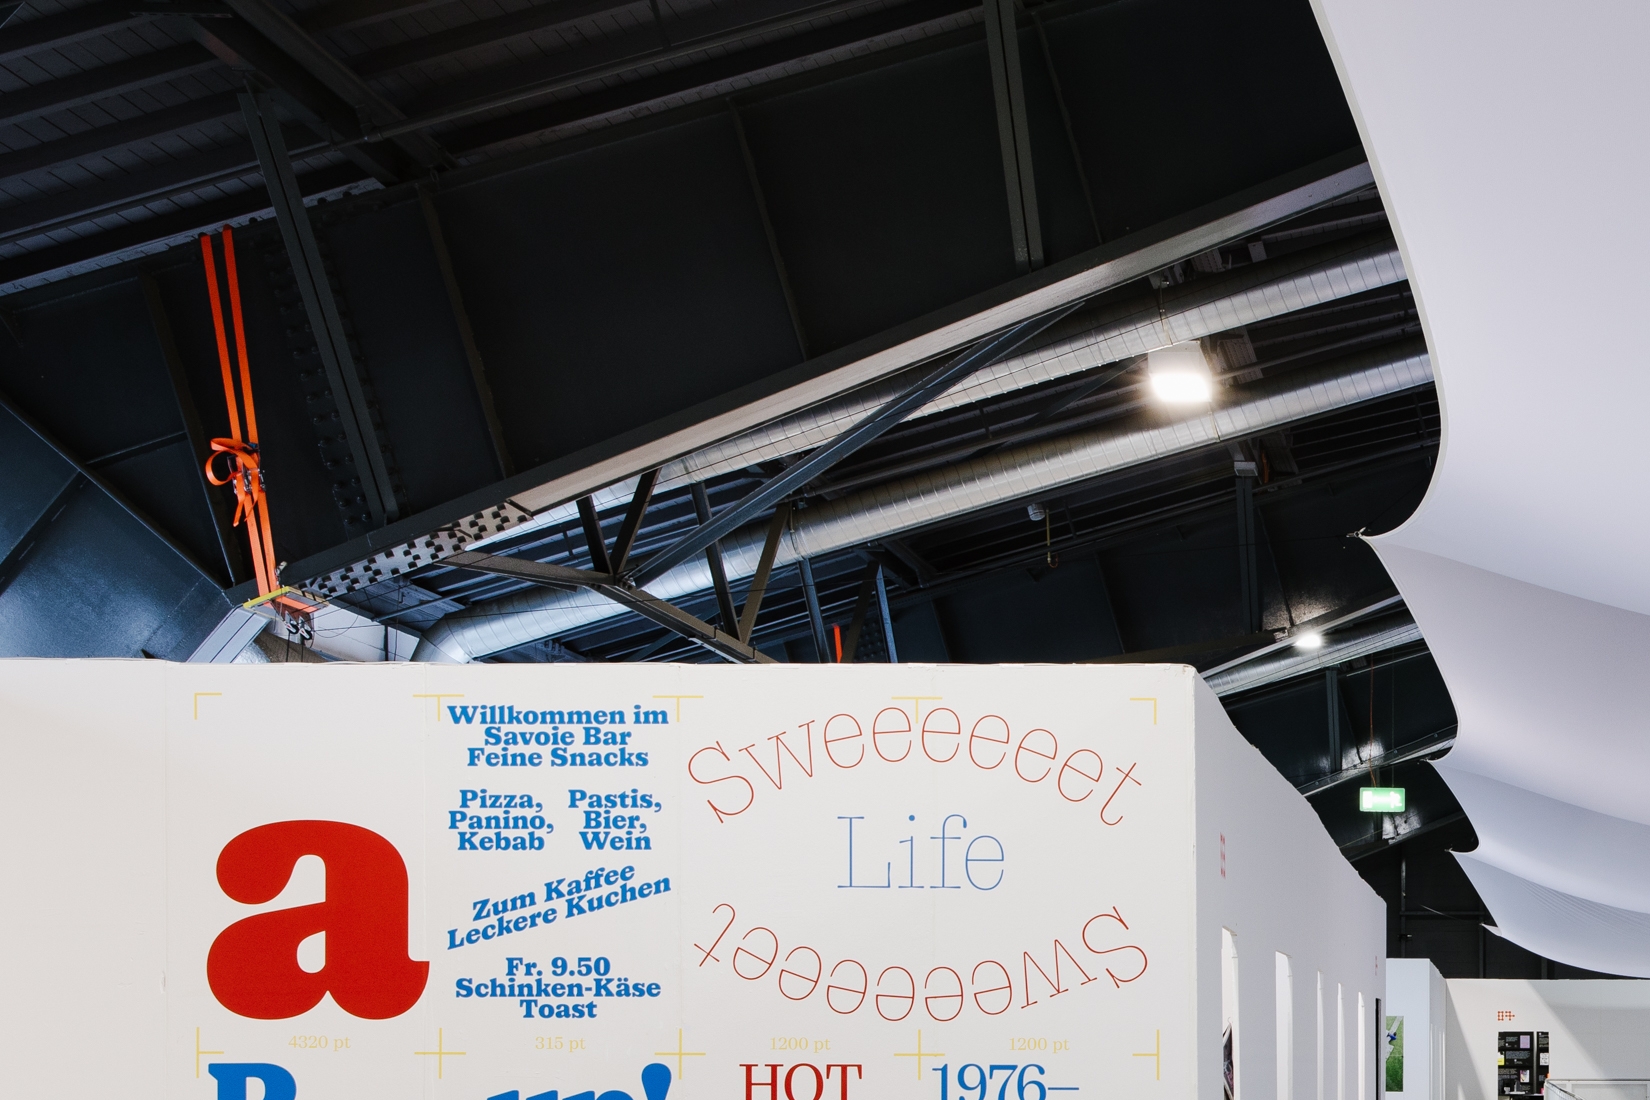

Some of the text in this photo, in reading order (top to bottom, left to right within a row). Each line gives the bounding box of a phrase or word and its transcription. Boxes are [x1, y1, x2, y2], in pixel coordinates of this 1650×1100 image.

[447, 705, 668, 724] Willkommen im
[484, 727, 632, 746] Savoie Bar
[467, 747, 649, 767] Feine Snacks
[688, 707, 1142, 826] Sweeeeeet
[459, 789, 543, 811] Pizza,
[568, 789, 662, 811] Pastis,
[448, 810, 554, 832] Panino,
[583, 810, 647, 832] Bier,
[457, 832, 545, 850] Kebab
[579, 832, 652, 850] Wein
[837, 814, 1005, 890] Life
[472, 865, 636, 922] Zum Kaffee
[206, 819, 430, 1020] a
[447, 877, 672, 950] Leckere Kuchen
[505, 957, 611, 976] Fr. 9.50
[455, 977, 662, 998] Schinken-Käse
[519, 999, 598, 1018] Toast
[288, 1035, 351, 1053] 4320 pt
[535, 1036, 586, 1053] 315 pt
[769, 1036, 831, 1054] 1200 pt
[1008, 1036, 1070, 1054] 1200 pt
